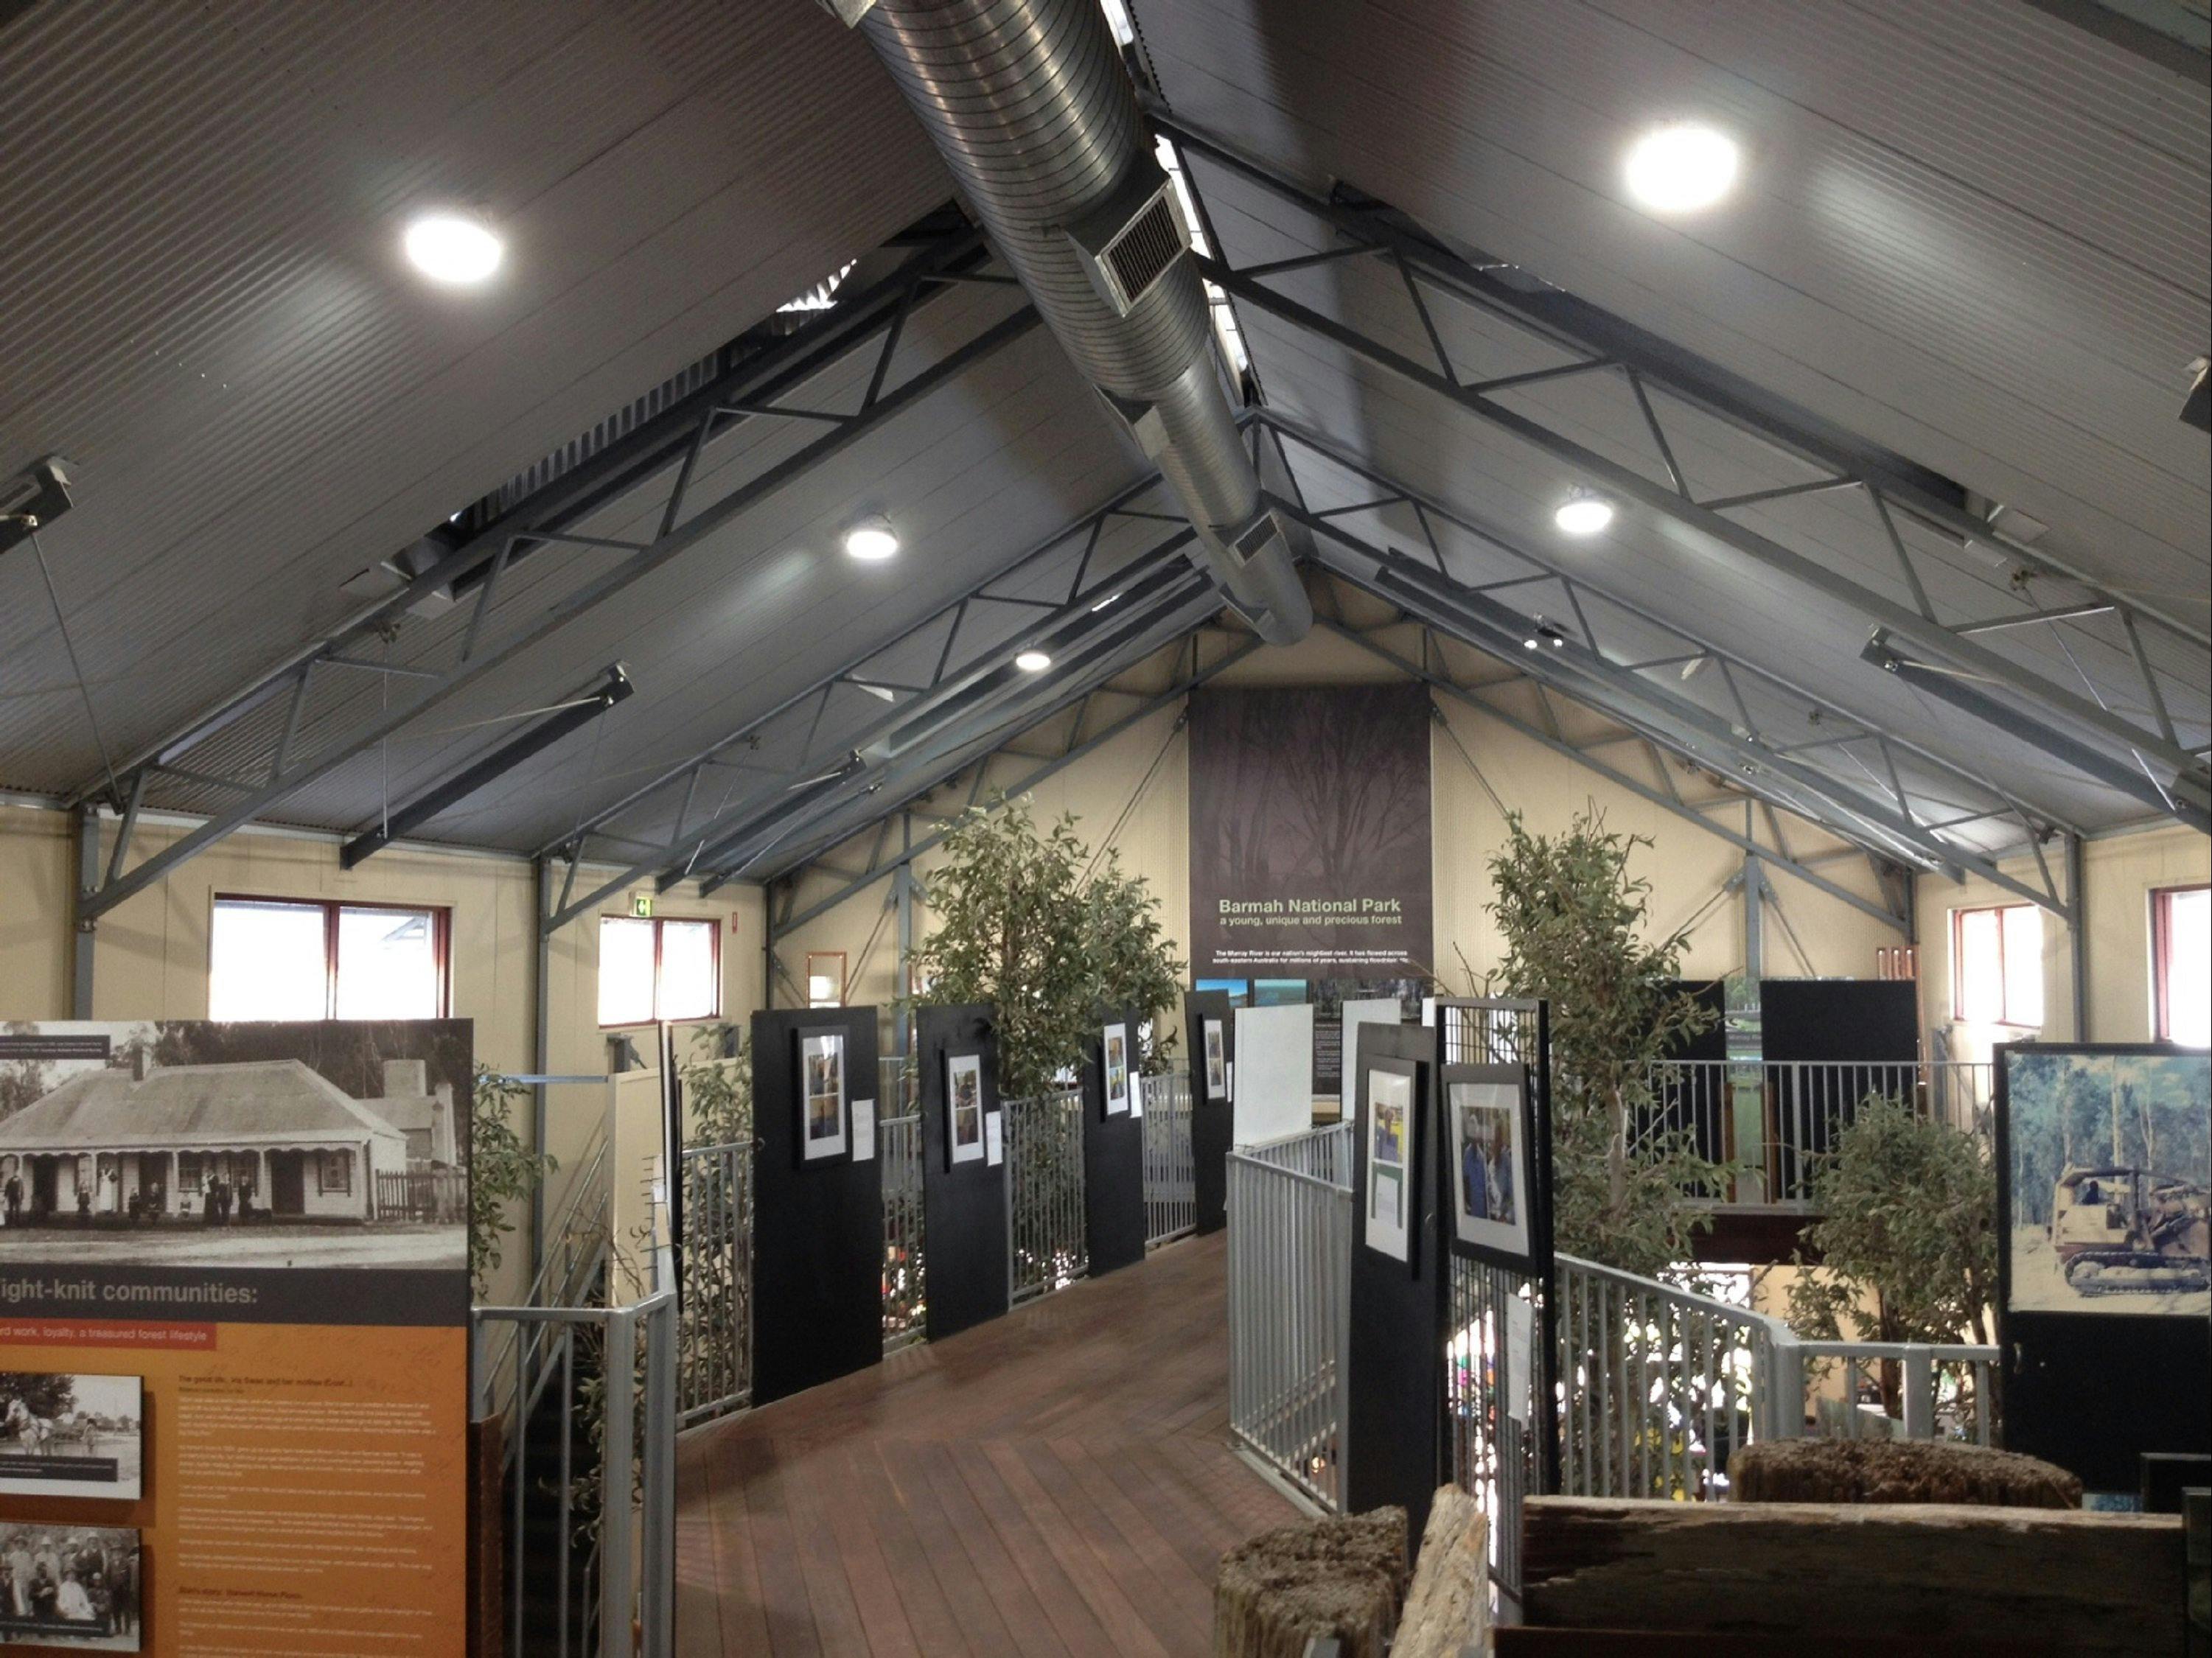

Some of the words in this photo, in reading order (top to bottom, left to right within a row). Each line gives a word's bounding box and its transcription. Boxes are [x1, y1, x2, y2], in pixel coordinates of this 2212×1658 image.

[1219, 899, 1283, 913] Barmah
[1288, 898, 1356, 913] National
[1362, 898, 1401, 912] Park
[1228, 917, 1263, 927] young,
[1265, 916, 1300, 926] unique
[1302, 915, 1322, 926] and
[1324, 915, 1370, 926] precious
[1371, 915, 1402, 925] forest
[0, 1279, 97, 1304] ight-knit
[102, 1282, 258, 1304] communities:
[0, 1326, 10, 1336] rd
[88, 1329, 136, 1339] treasured
[138, 1329, 167, 1339] forest
[170, 1330, 207, 1342] lifestyle
